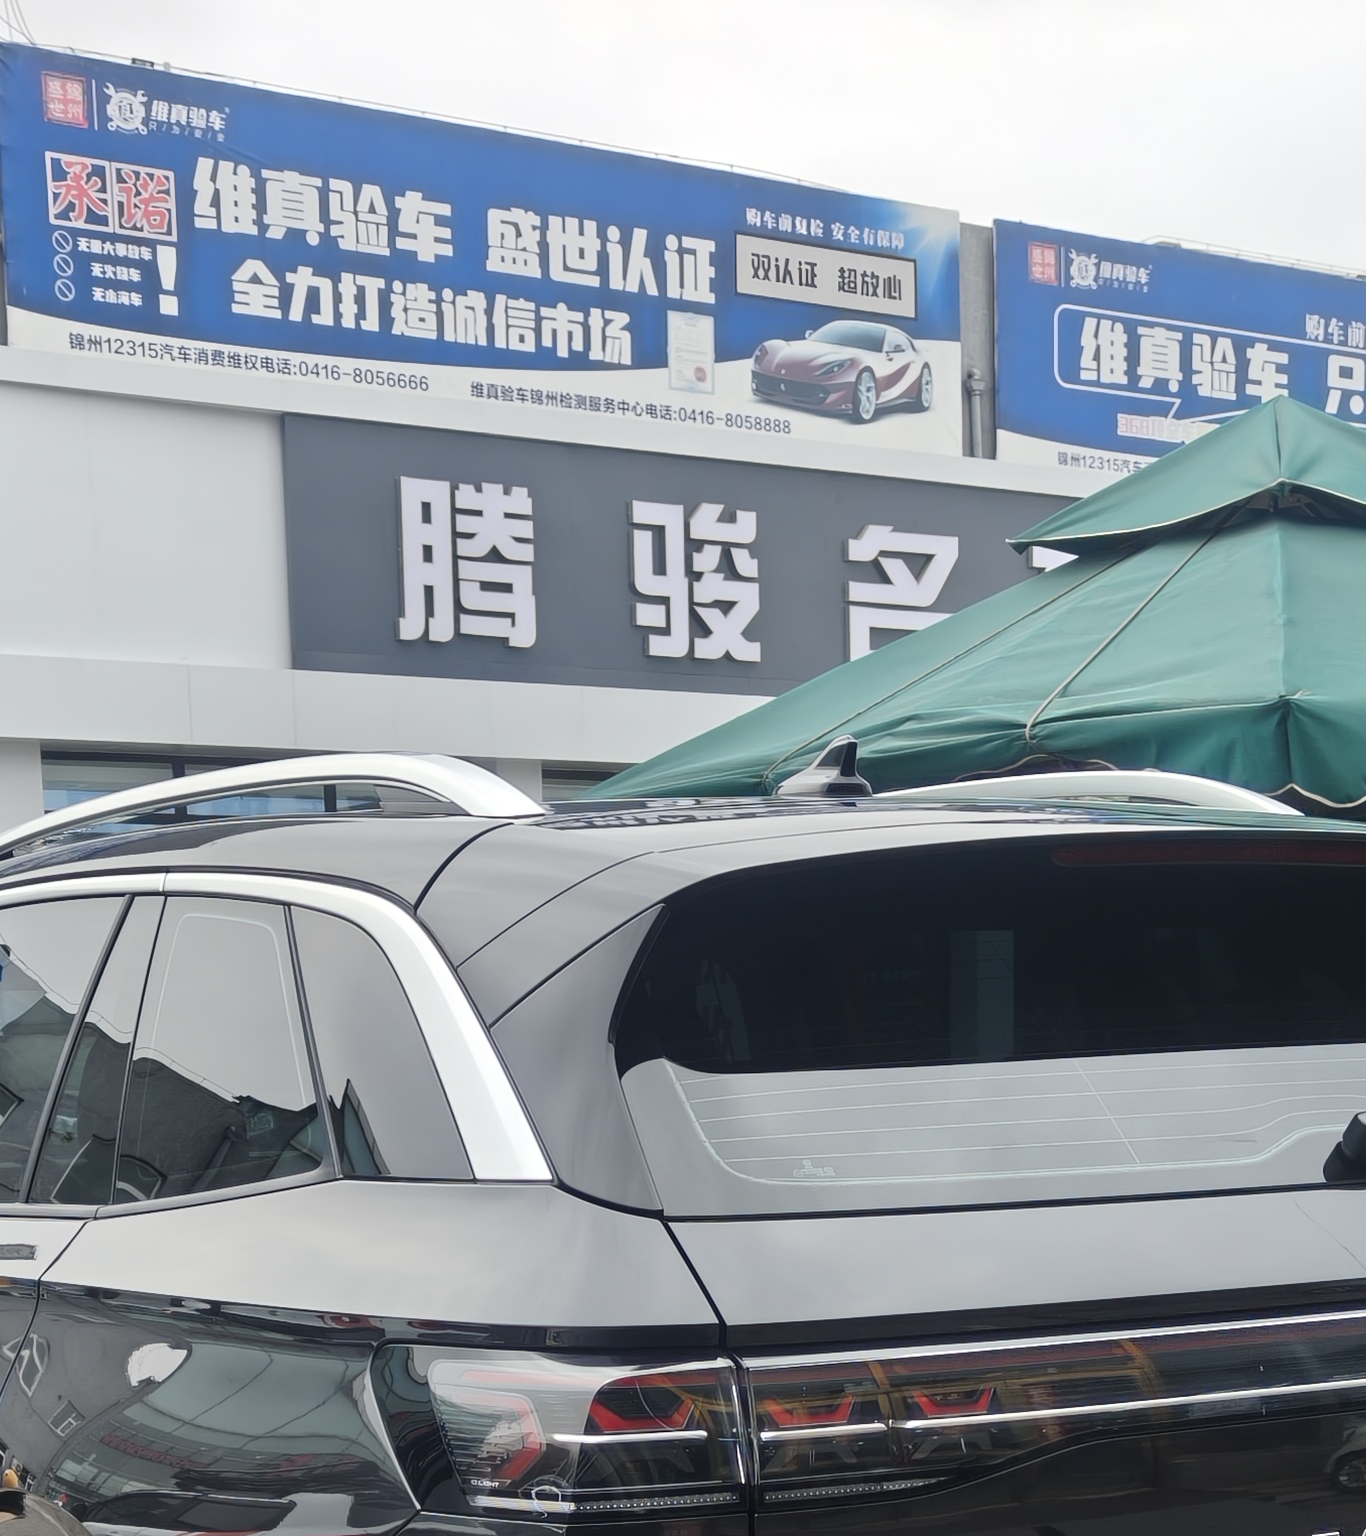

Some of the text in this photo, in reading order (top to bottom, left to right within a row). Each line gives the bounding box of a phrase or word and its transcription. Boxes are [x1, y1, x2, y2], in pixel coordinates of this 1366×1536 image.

[149, 99, 226, 131] 维真验车
[50, 160, 172, 232] 承诺
[192, 156, 716, 305] 维真验车 盛世认证
[745, 206, 906, 251] 购车前复检 安全有保障
[750, 252, 903, 302] 双认证 超放心
[231, 258, 632, 367] 全力打造诚信市场
[68, 332, 430, 392] 锦州12315汽车消费维权电话:0416-8056666
[1080, 316, 1290, 403] 维真验车
[470, 381, 792, 436] 维真验车锦州检测服务中心电话:0416-8058888
[1057, 450, 1152, 474] 锦州12315汽车
[397, 475, 1078, 664] 腾骏名
